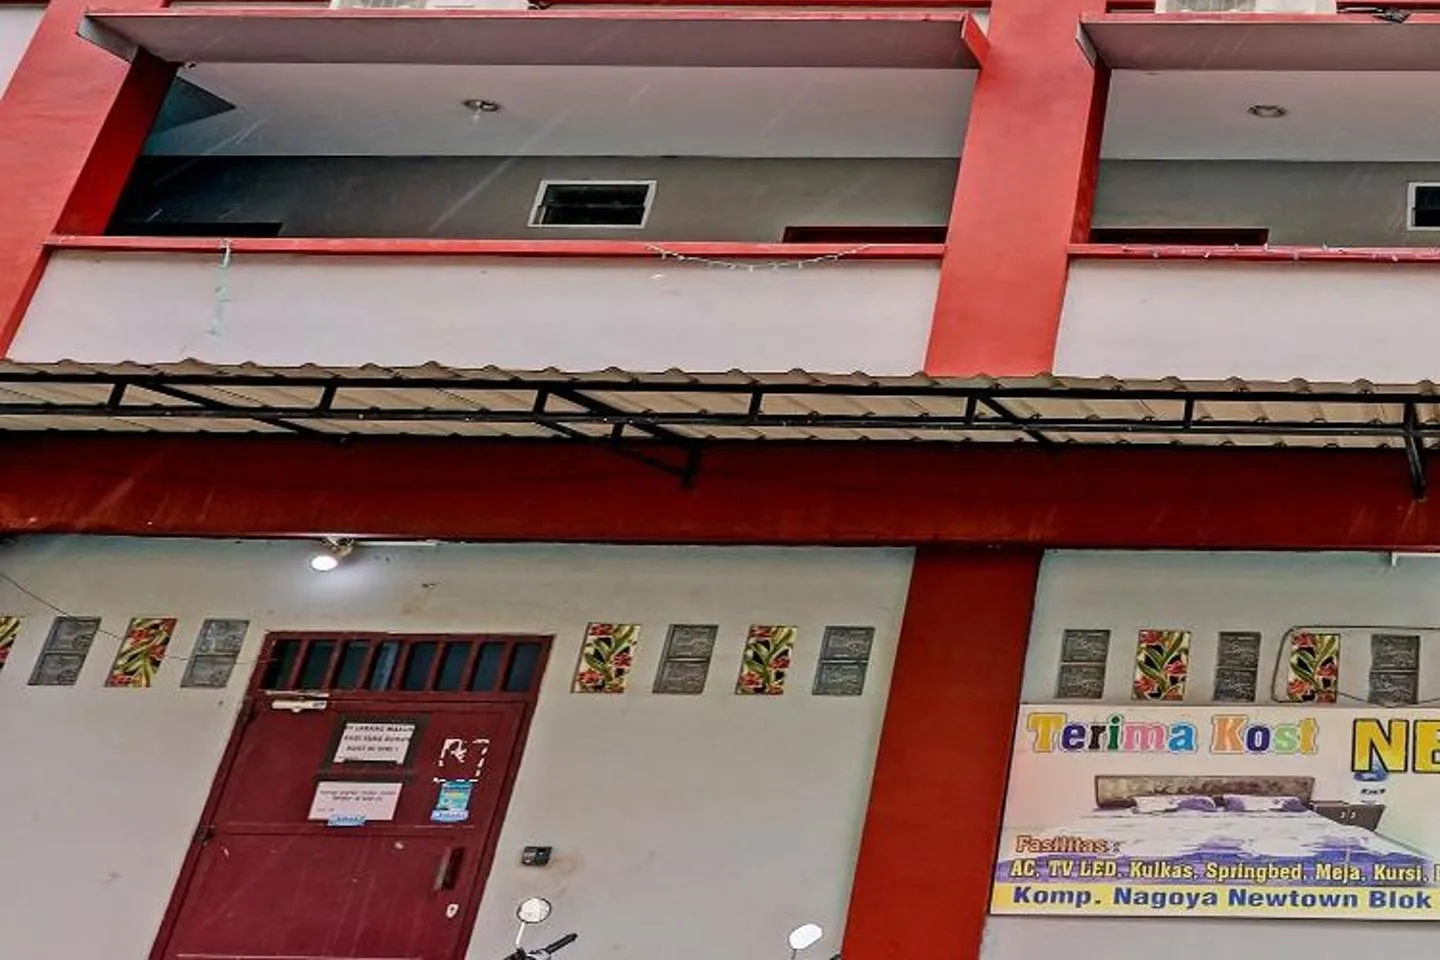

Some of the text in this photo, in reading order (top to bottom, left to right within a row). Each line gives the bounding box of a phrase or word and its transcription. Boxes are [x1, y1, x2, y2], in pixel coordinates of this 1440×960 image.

[1027, 711, 1319, 756] Terima Kost
[1048, 860, 1072, 877] TV
[1013, 887, 1101, 908] Komp.
[1113, 887, 1217, 909] Nagoya
[1228, 889, 1358, 908] Newtown
[1368, 890, 1431, 909] Blok
